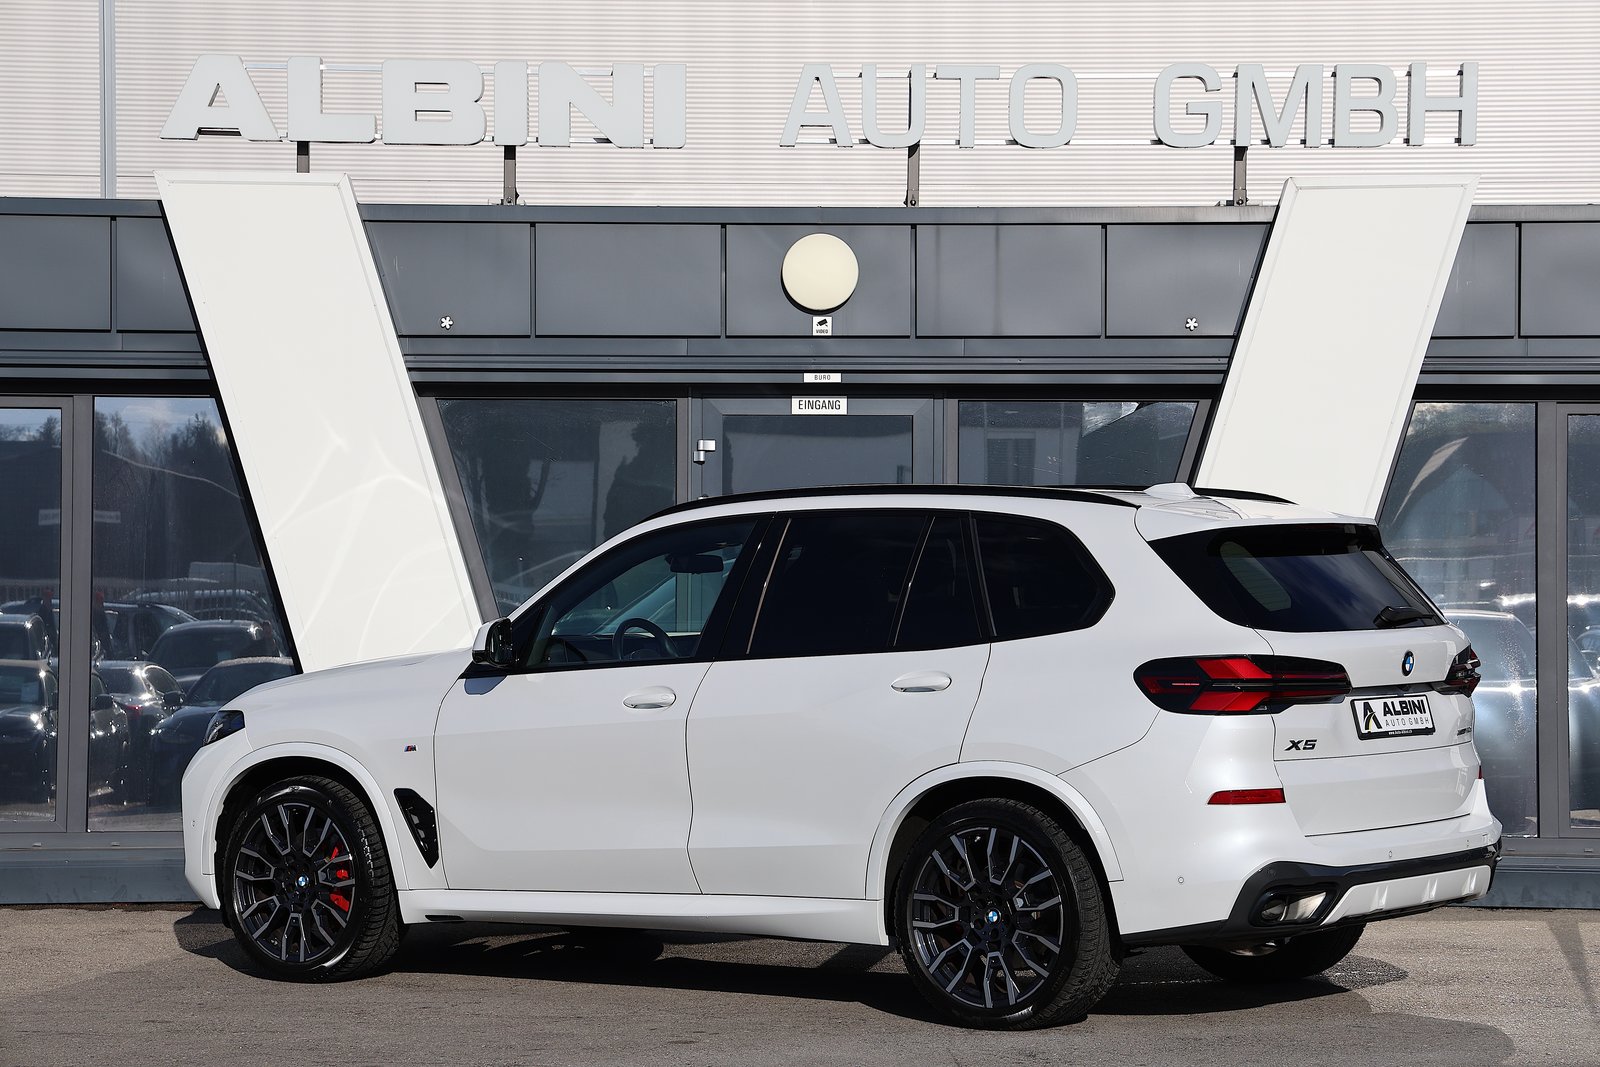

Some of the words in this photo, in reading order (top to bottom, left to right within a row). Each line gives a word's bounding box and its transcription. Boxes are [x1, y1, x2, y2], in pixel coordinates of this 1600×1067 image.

[159, 54, 687, 149] ALBINI
[779, 62, 1079, 149] AUTO
[1152, 61, 1479, 149] GMBH
[798, 400, 841, 410] EINGANG
[1383, 700, 1426, 716] ALBINI
[1385, 717, 1407, 727] AUTO
[1408, 716, 1430, 726] GMBH
[1283, 739, 1318, 751] X5
